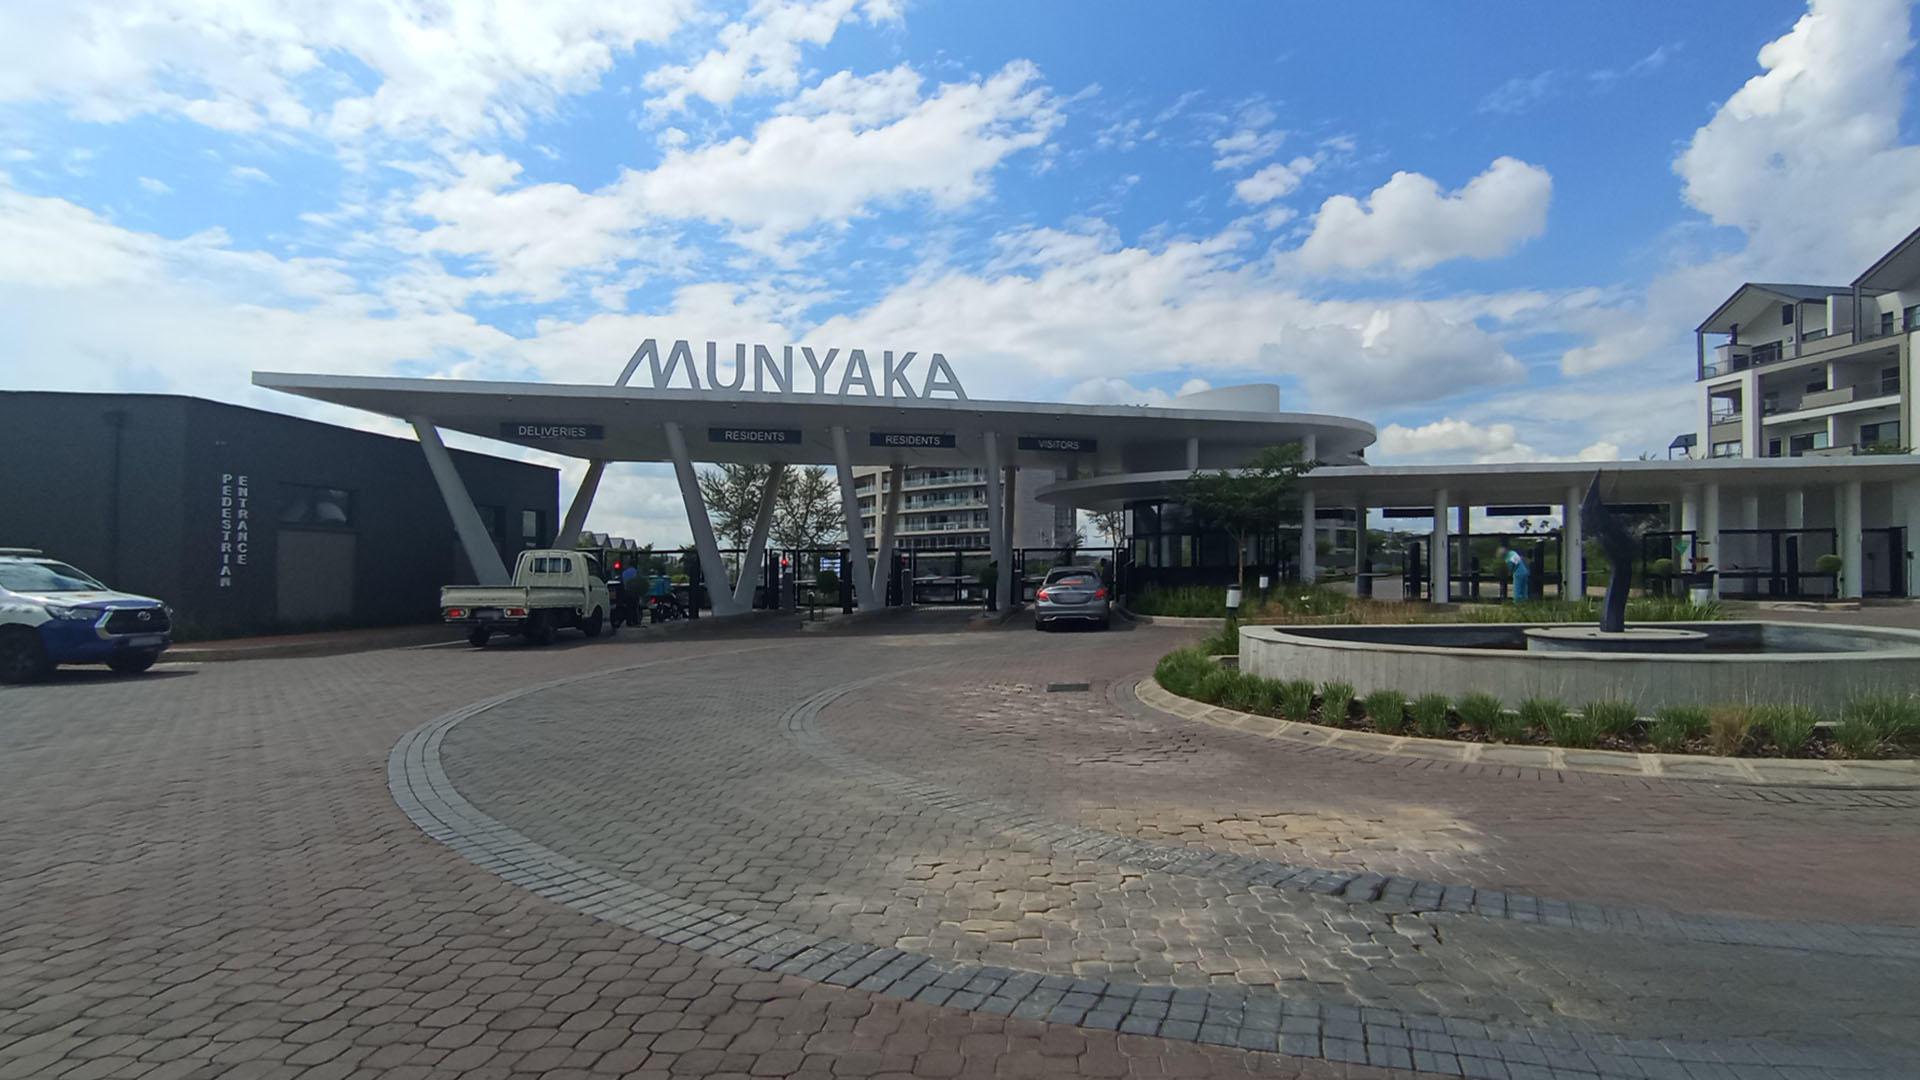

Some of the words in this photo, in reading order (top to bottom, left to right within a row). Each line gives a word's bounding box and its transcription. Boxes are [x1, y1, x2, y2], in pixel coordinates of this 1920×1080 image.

[615, 339, 968, 400] MUNYAKA
[518, 425, 586, 437] DELIVERIES
[725, 430, 785, 441] RESIDENTS
[885, 435, 941, 446] RESIDENTS
[1038, 439, 1080, 450] VISITORS
[237, 475, 248, 565] ENTRANCE
[220, 473, 233, 587] PEDESTRIAN
